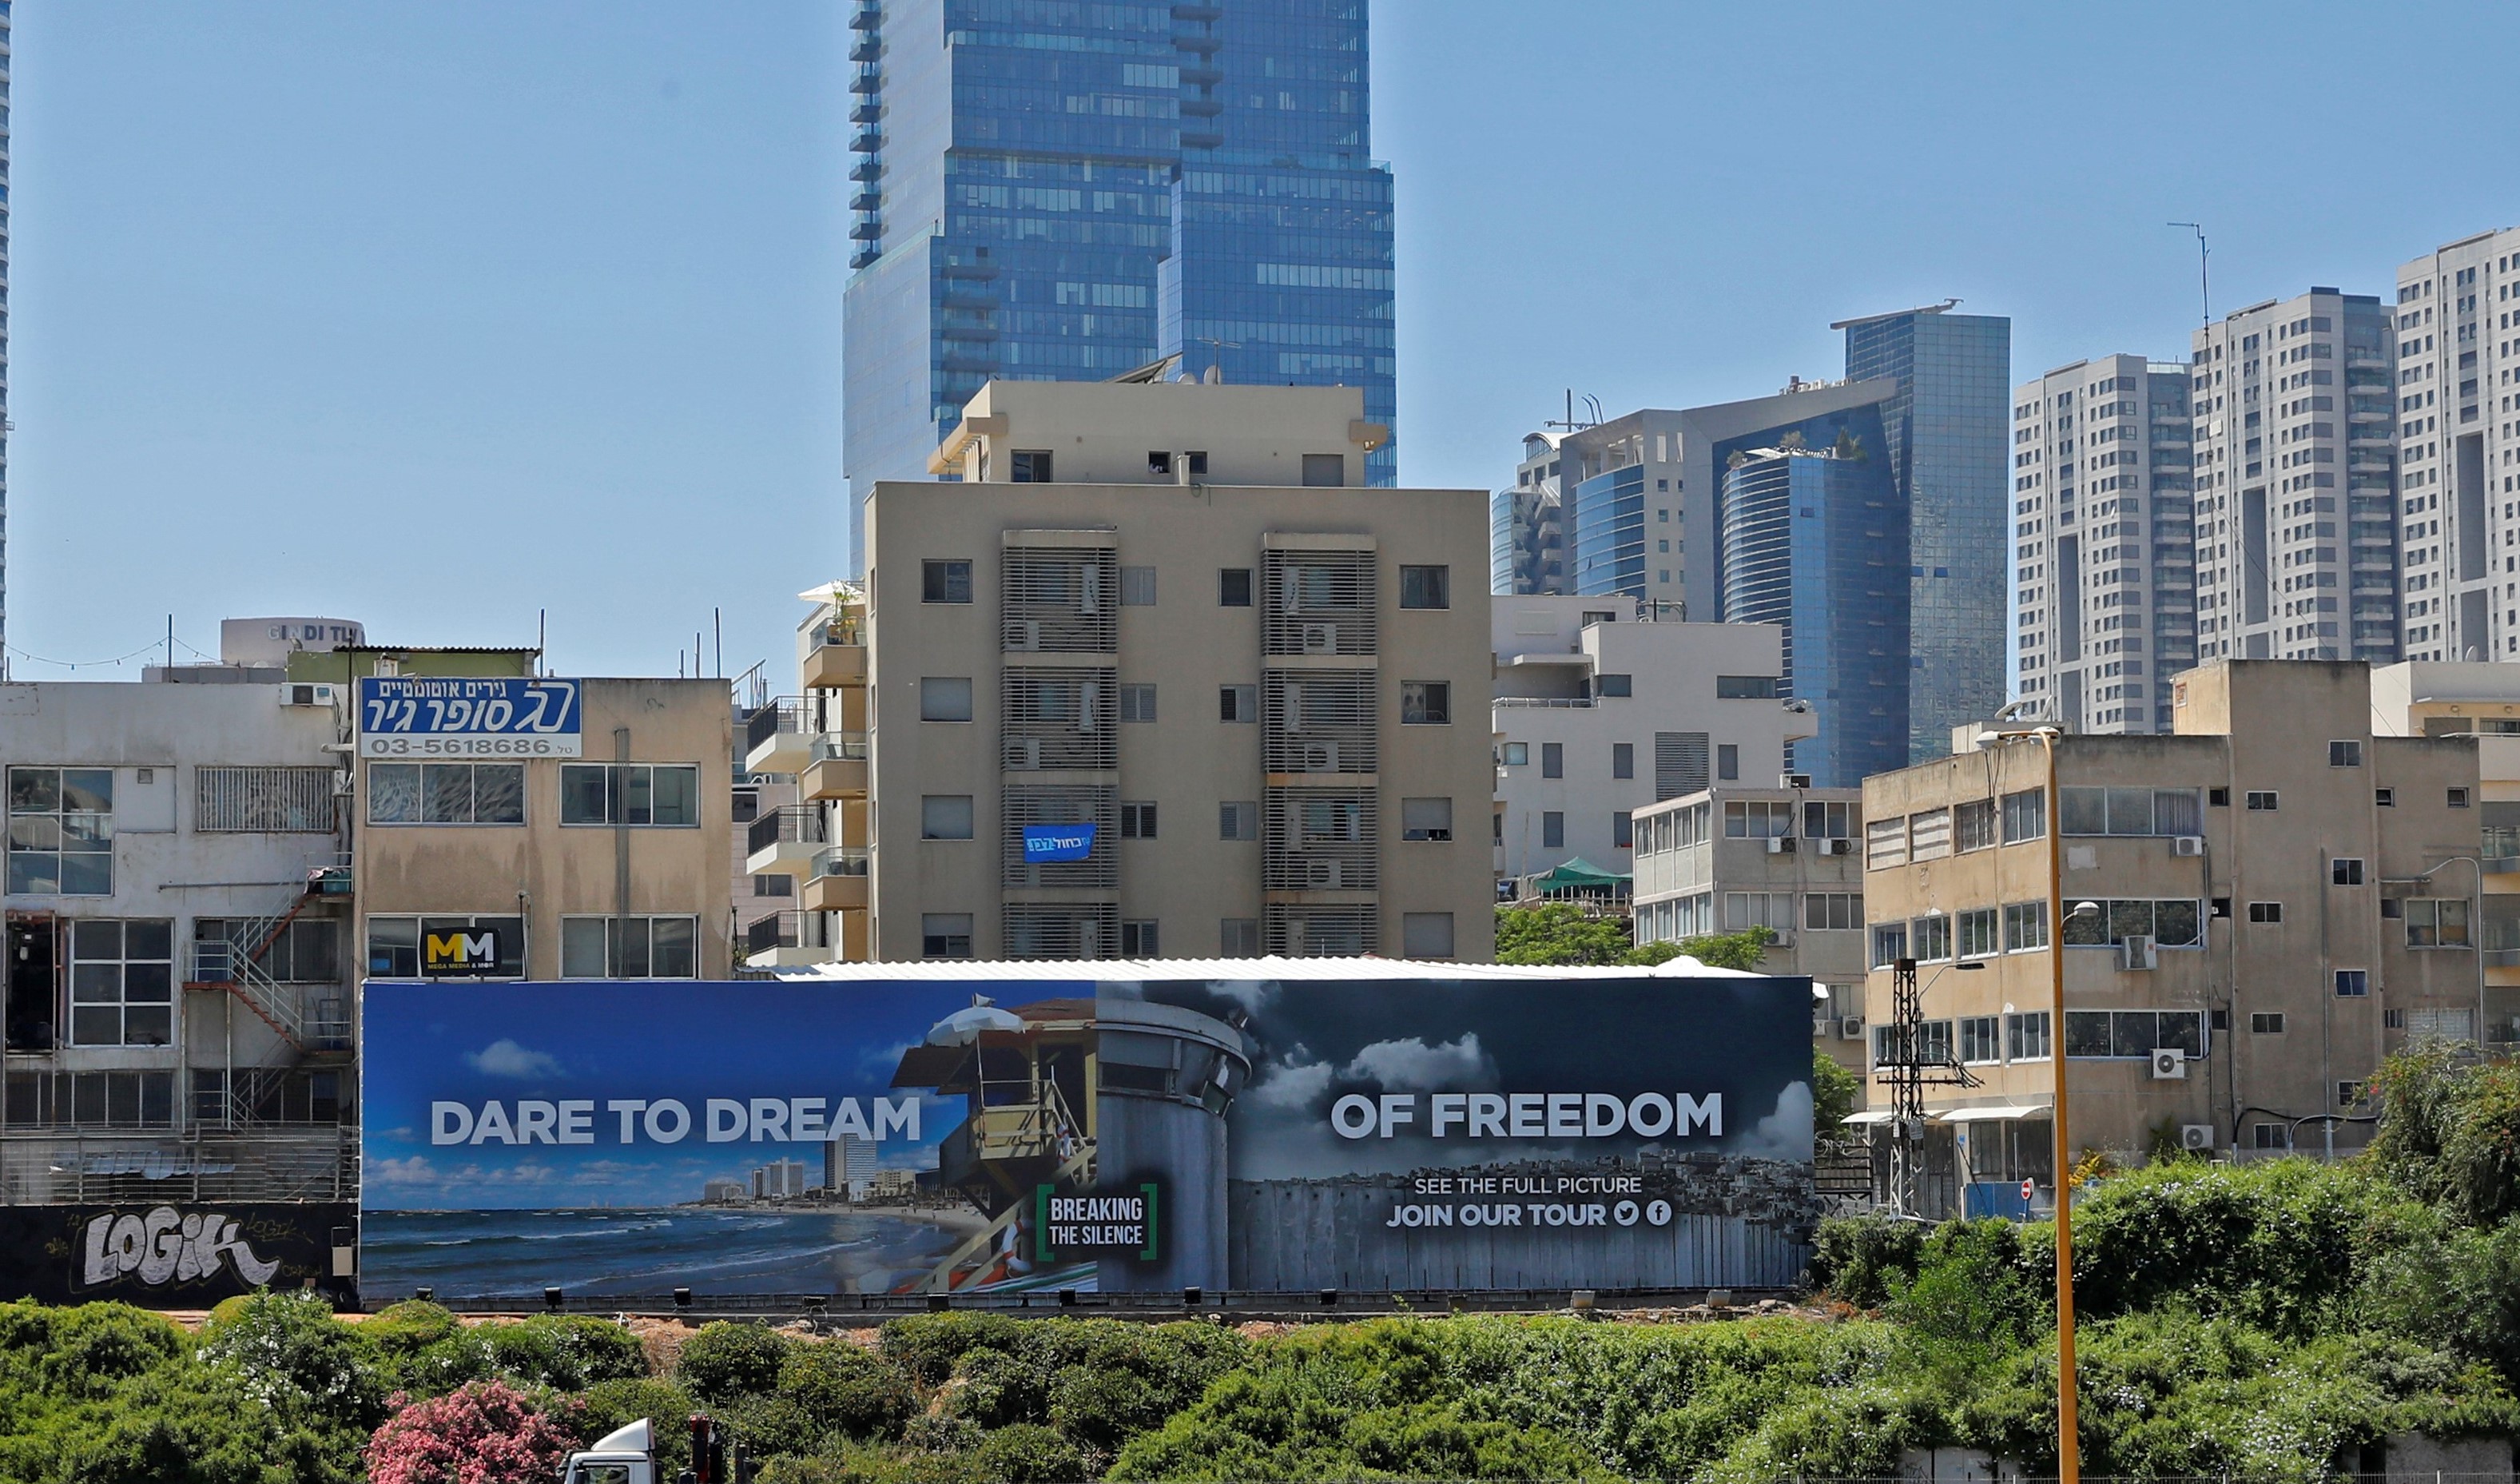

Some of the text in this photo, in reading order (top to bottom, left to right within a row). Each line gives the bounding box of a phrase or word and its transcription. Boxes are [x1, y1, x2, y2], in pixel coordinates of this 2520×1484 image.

[268, 625, 324, 640] GINDI
[379, 682, 507, 698] גירים אוטומטיים
[368, 699, 513, 733] סופר גיר
[371, 738, 551, 754] 03-5618686
[1052, 837, 1083, 849] כחול
[427, 933, 494, 963] MM
[431, 1096, 920, 1145] DARE TO DREAM
[1331, 1092, 1723, 1140] OF FREEDOM
[1414, 1177, 1642, 1195] SEE THE FULL PICTURE
[1051, 1197, 1143, 1221] BREAKING
[1385, 1204, 1453, 1227] JOIN
[1459, 1204, 1522, 1227] OUR
[1527, 1204, 1607, 1226] TOUR
[1049, 1225, 1143, 1245] THE SILENCE
